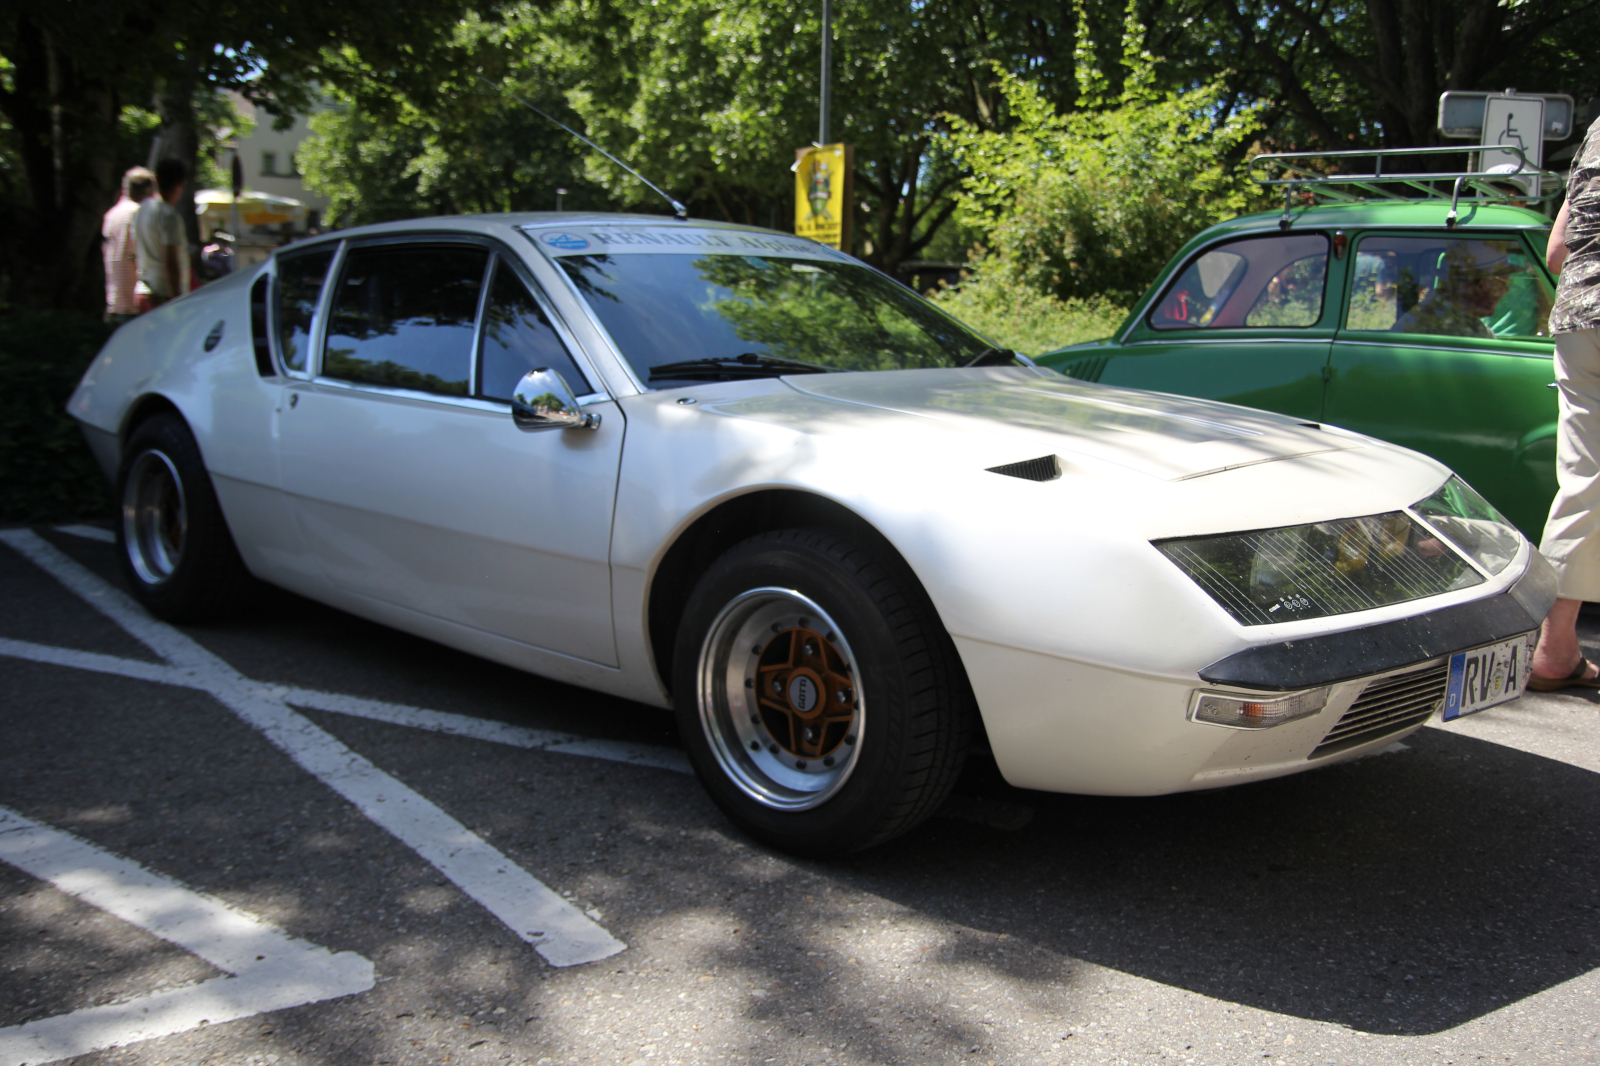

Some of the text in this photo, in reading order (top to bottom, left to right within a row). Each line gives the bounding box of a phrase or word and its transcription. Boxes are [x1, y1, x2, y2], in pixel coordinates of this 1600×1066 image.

[590, 233, 817, 254] RENAULT Alpine
[1461, 645, 1518, 708] RV A
[798, 678, 807, 710] GOTTI
[1449, 693, 1456, 708] D
